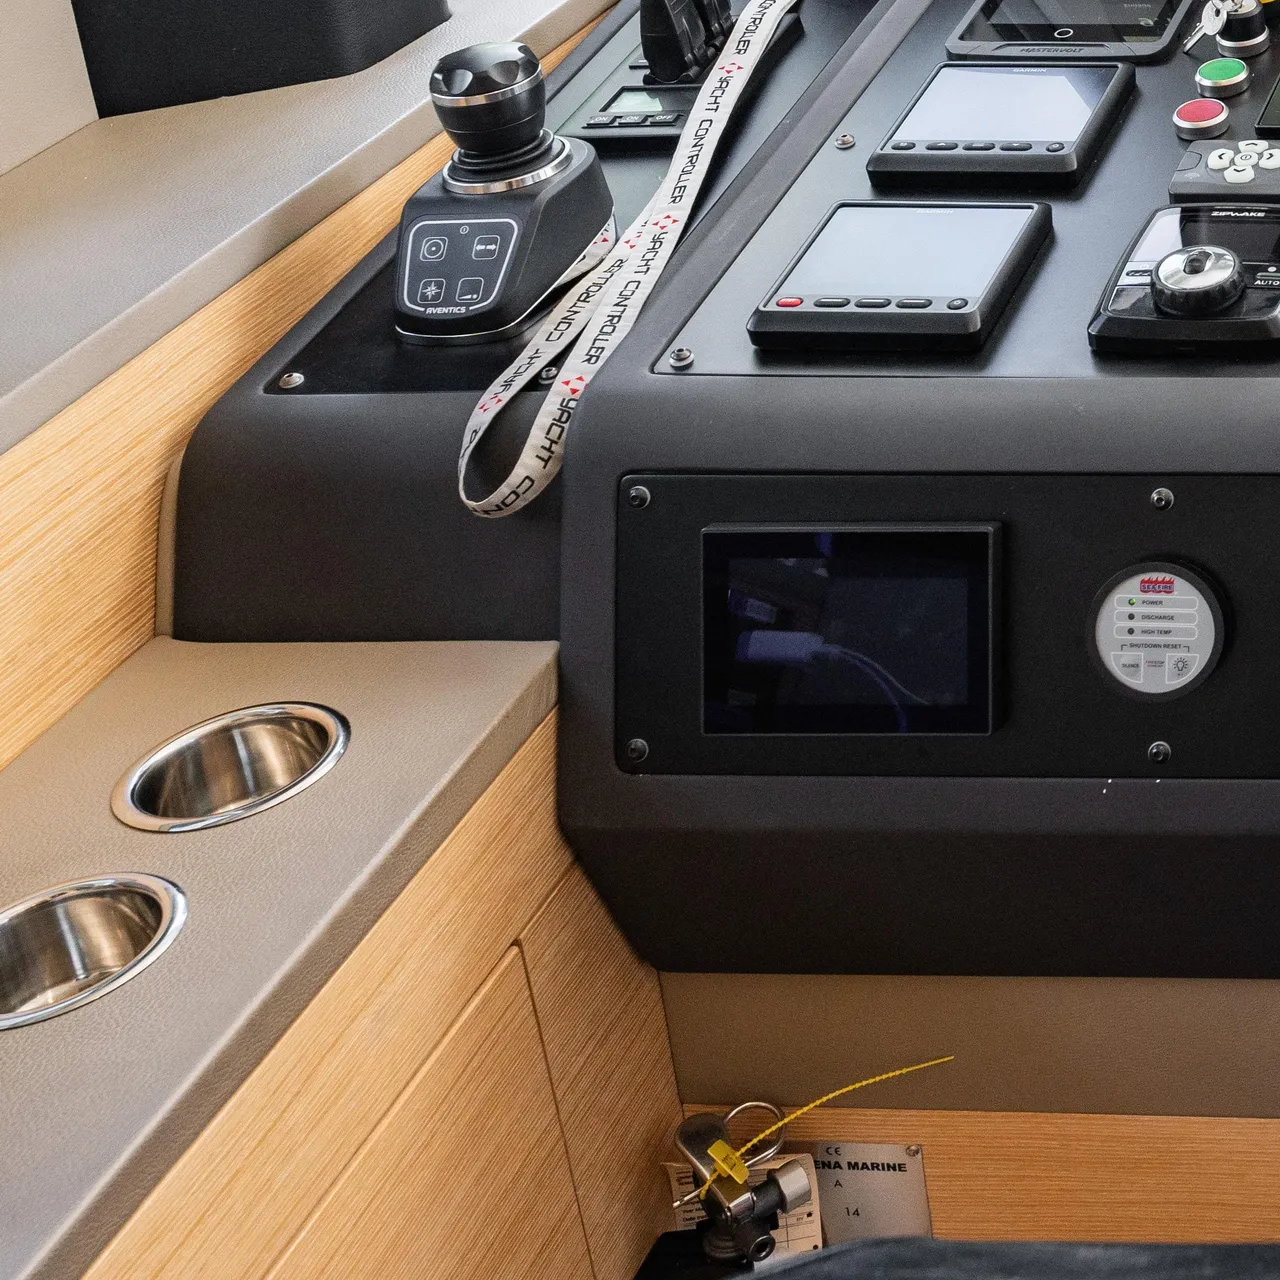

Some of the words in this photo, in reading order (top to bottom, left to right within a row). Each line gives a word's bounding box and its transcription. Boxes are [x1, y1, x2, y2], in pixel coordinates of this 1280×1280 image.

[710, 75, 734, 114] YACHT
[670, 118, 713, 205] CONTROLLER
[641, 230, 669, 275] YACHT
[426, 306, 466, 314] AVENTICS
[581, 280, 640, 365] CONTROLLER
[535, 397, 578, 470] YACHT
[825, 1146, 842, 1155] CE
[847, 1161, 907, 1172] MARINE
[834, 1179, 843, 1188] A
[846, 1207, 860, 1217] 14
